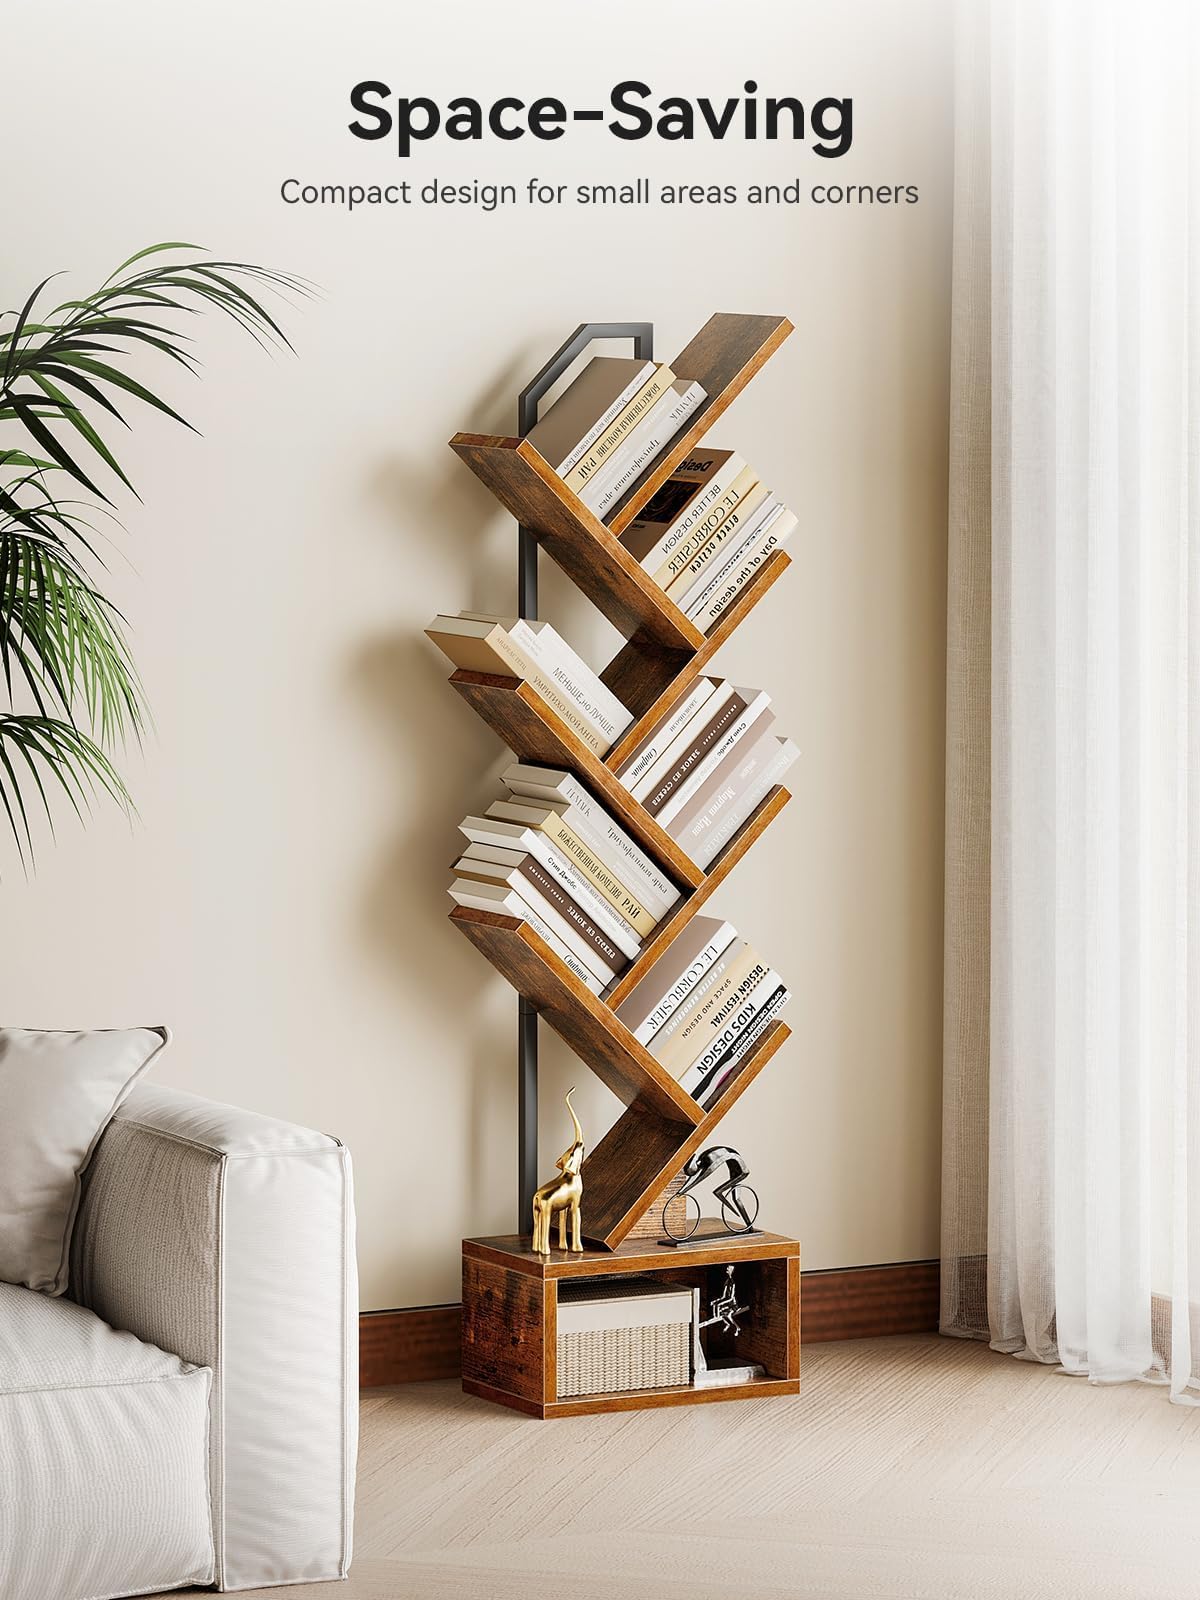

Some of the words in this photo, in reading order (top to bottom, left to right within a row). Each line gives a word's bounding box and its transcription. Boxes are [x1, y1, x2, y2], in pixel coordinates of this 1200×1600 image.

[577, 457, 597, 480] РАЙ
[620, 897, 642, 918] РАЙ
[701, 945, 718, 963] LE
[713, 978, 731, 999] SPACE
[737, 964, 763, 994] DESIGN
[646, 961, 705, 1030] CORBUSIER
[701, 998, 714, 1014] AND
[709, 992, 740, 1028] FESTIVAL
[730, 1002, 756, 1032] KIDS
[681, 1013, 702, 1038] DESIGN
[695, 1029, 734, 1074] DESIGN
